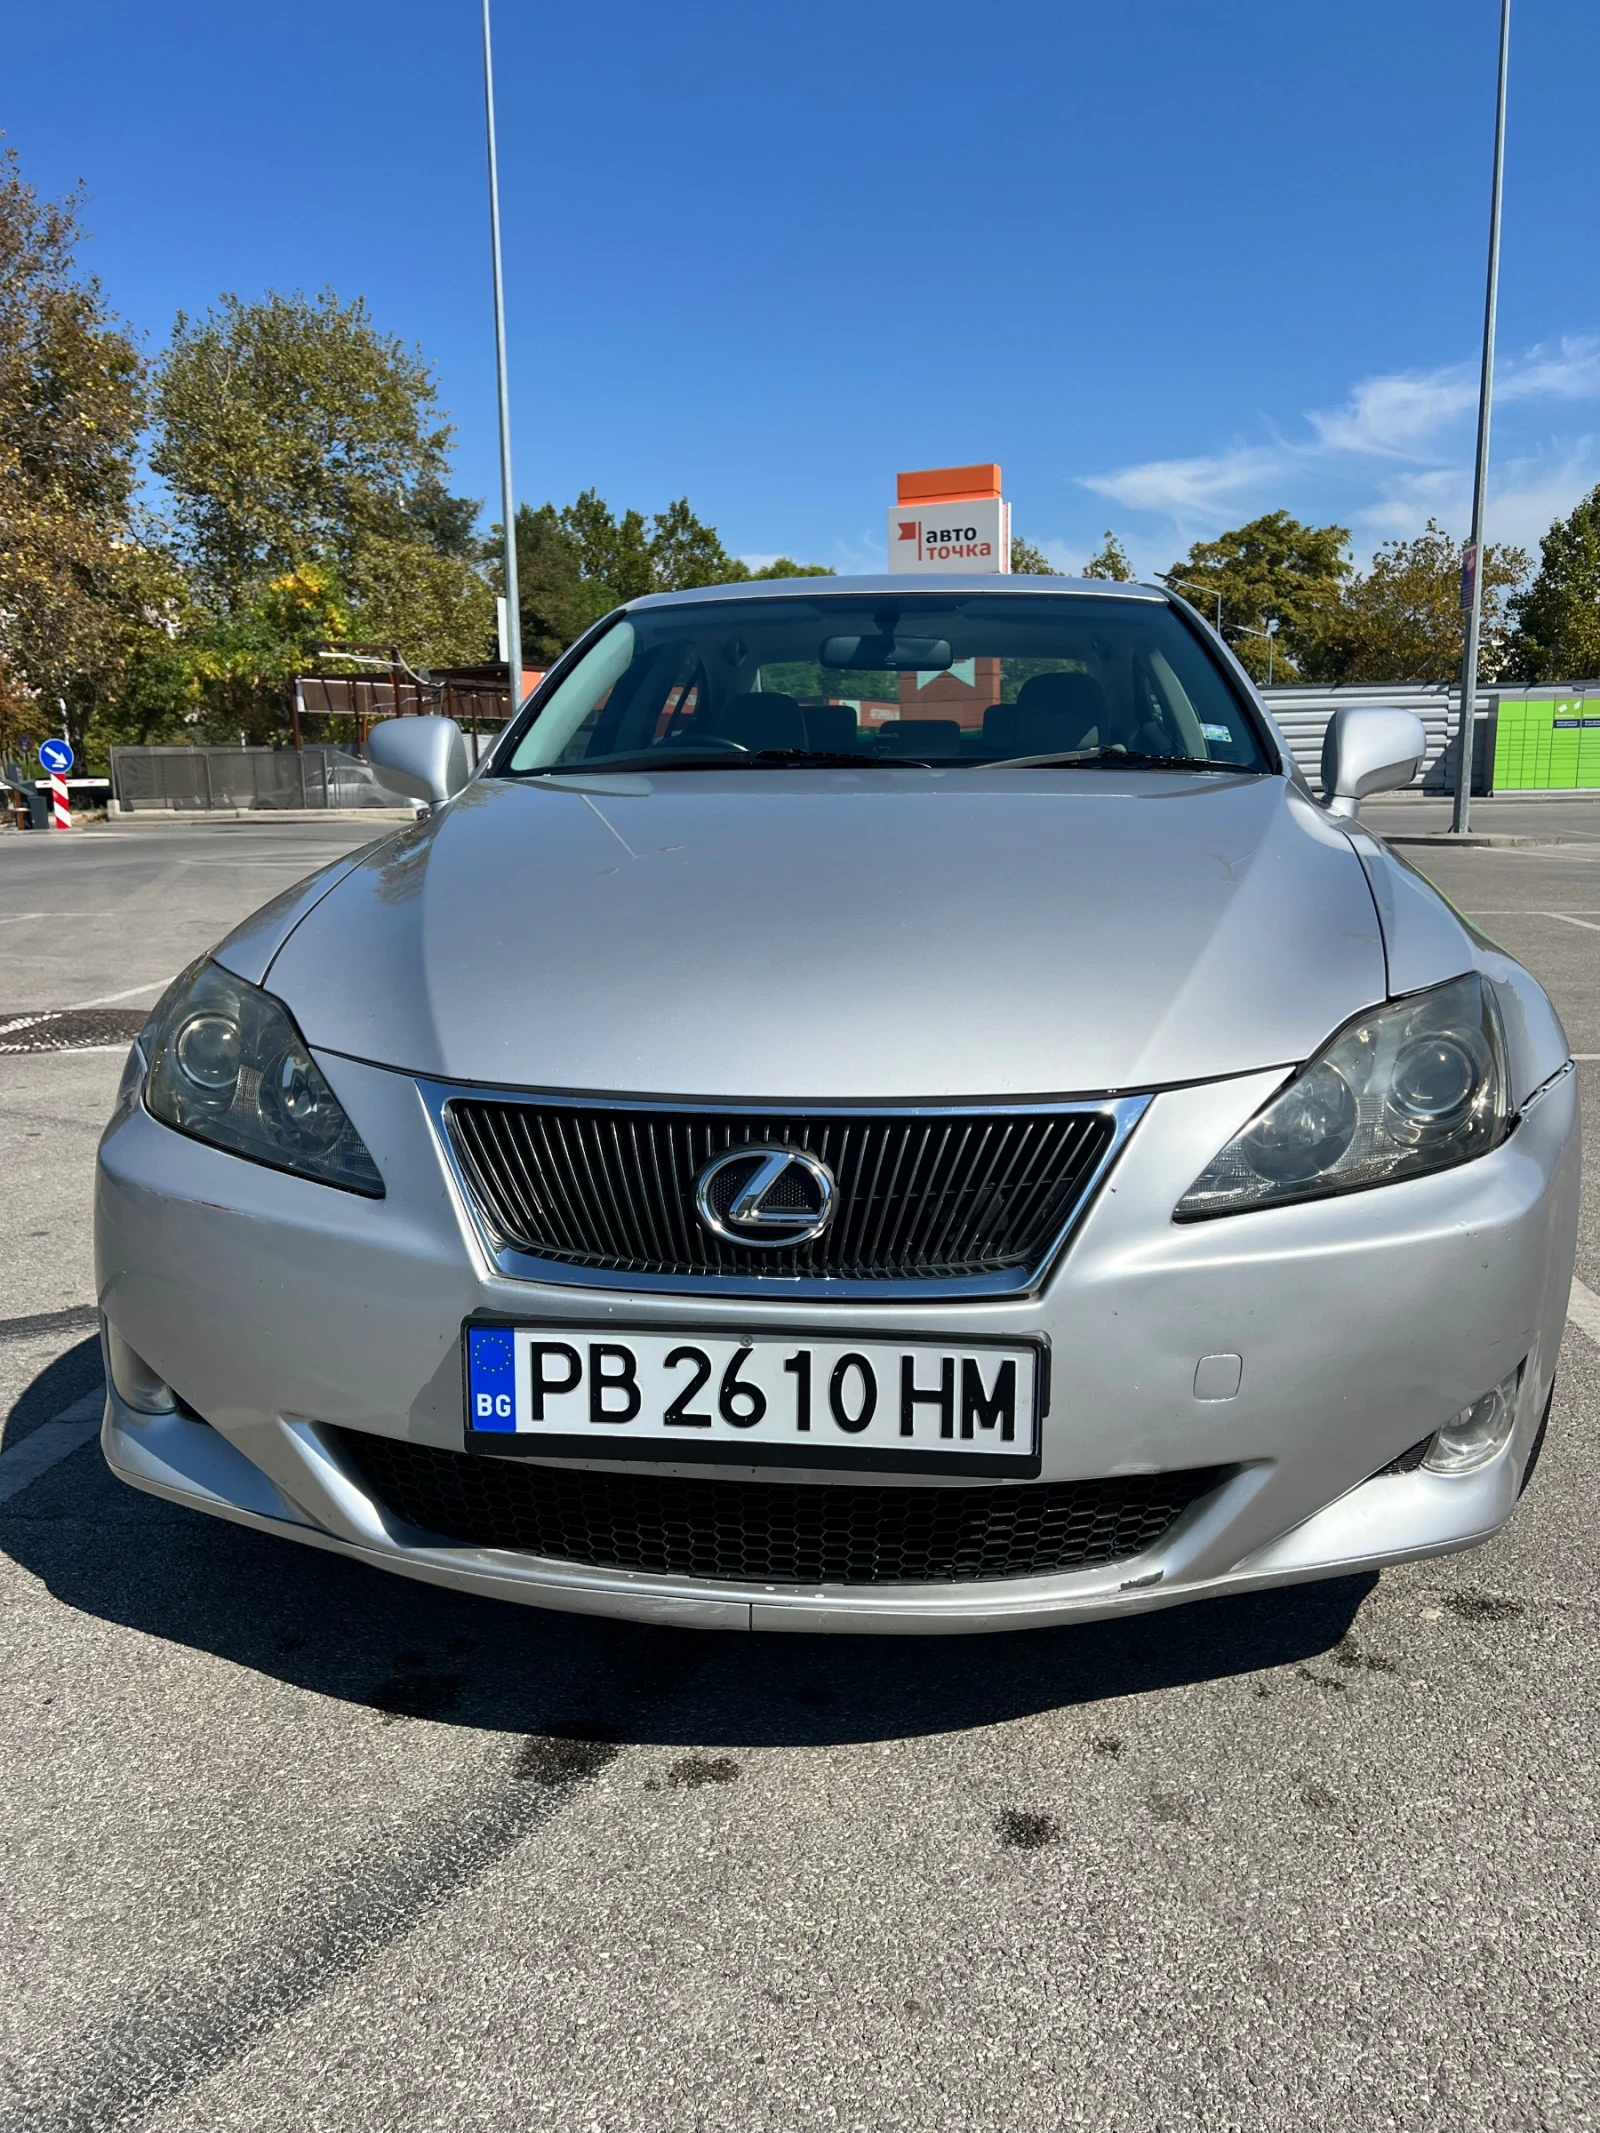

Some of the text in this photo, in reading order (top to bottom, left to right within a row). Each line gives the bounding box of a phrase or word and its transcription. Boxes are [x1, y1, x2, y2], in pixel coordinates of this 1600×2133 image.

[926, 527, 977, 544] авто
[926, 542, 991, 561] точка
[530, 1341, 1016, 1442] PB 2610 HM
[477, 1393, 512, 1418] BG
